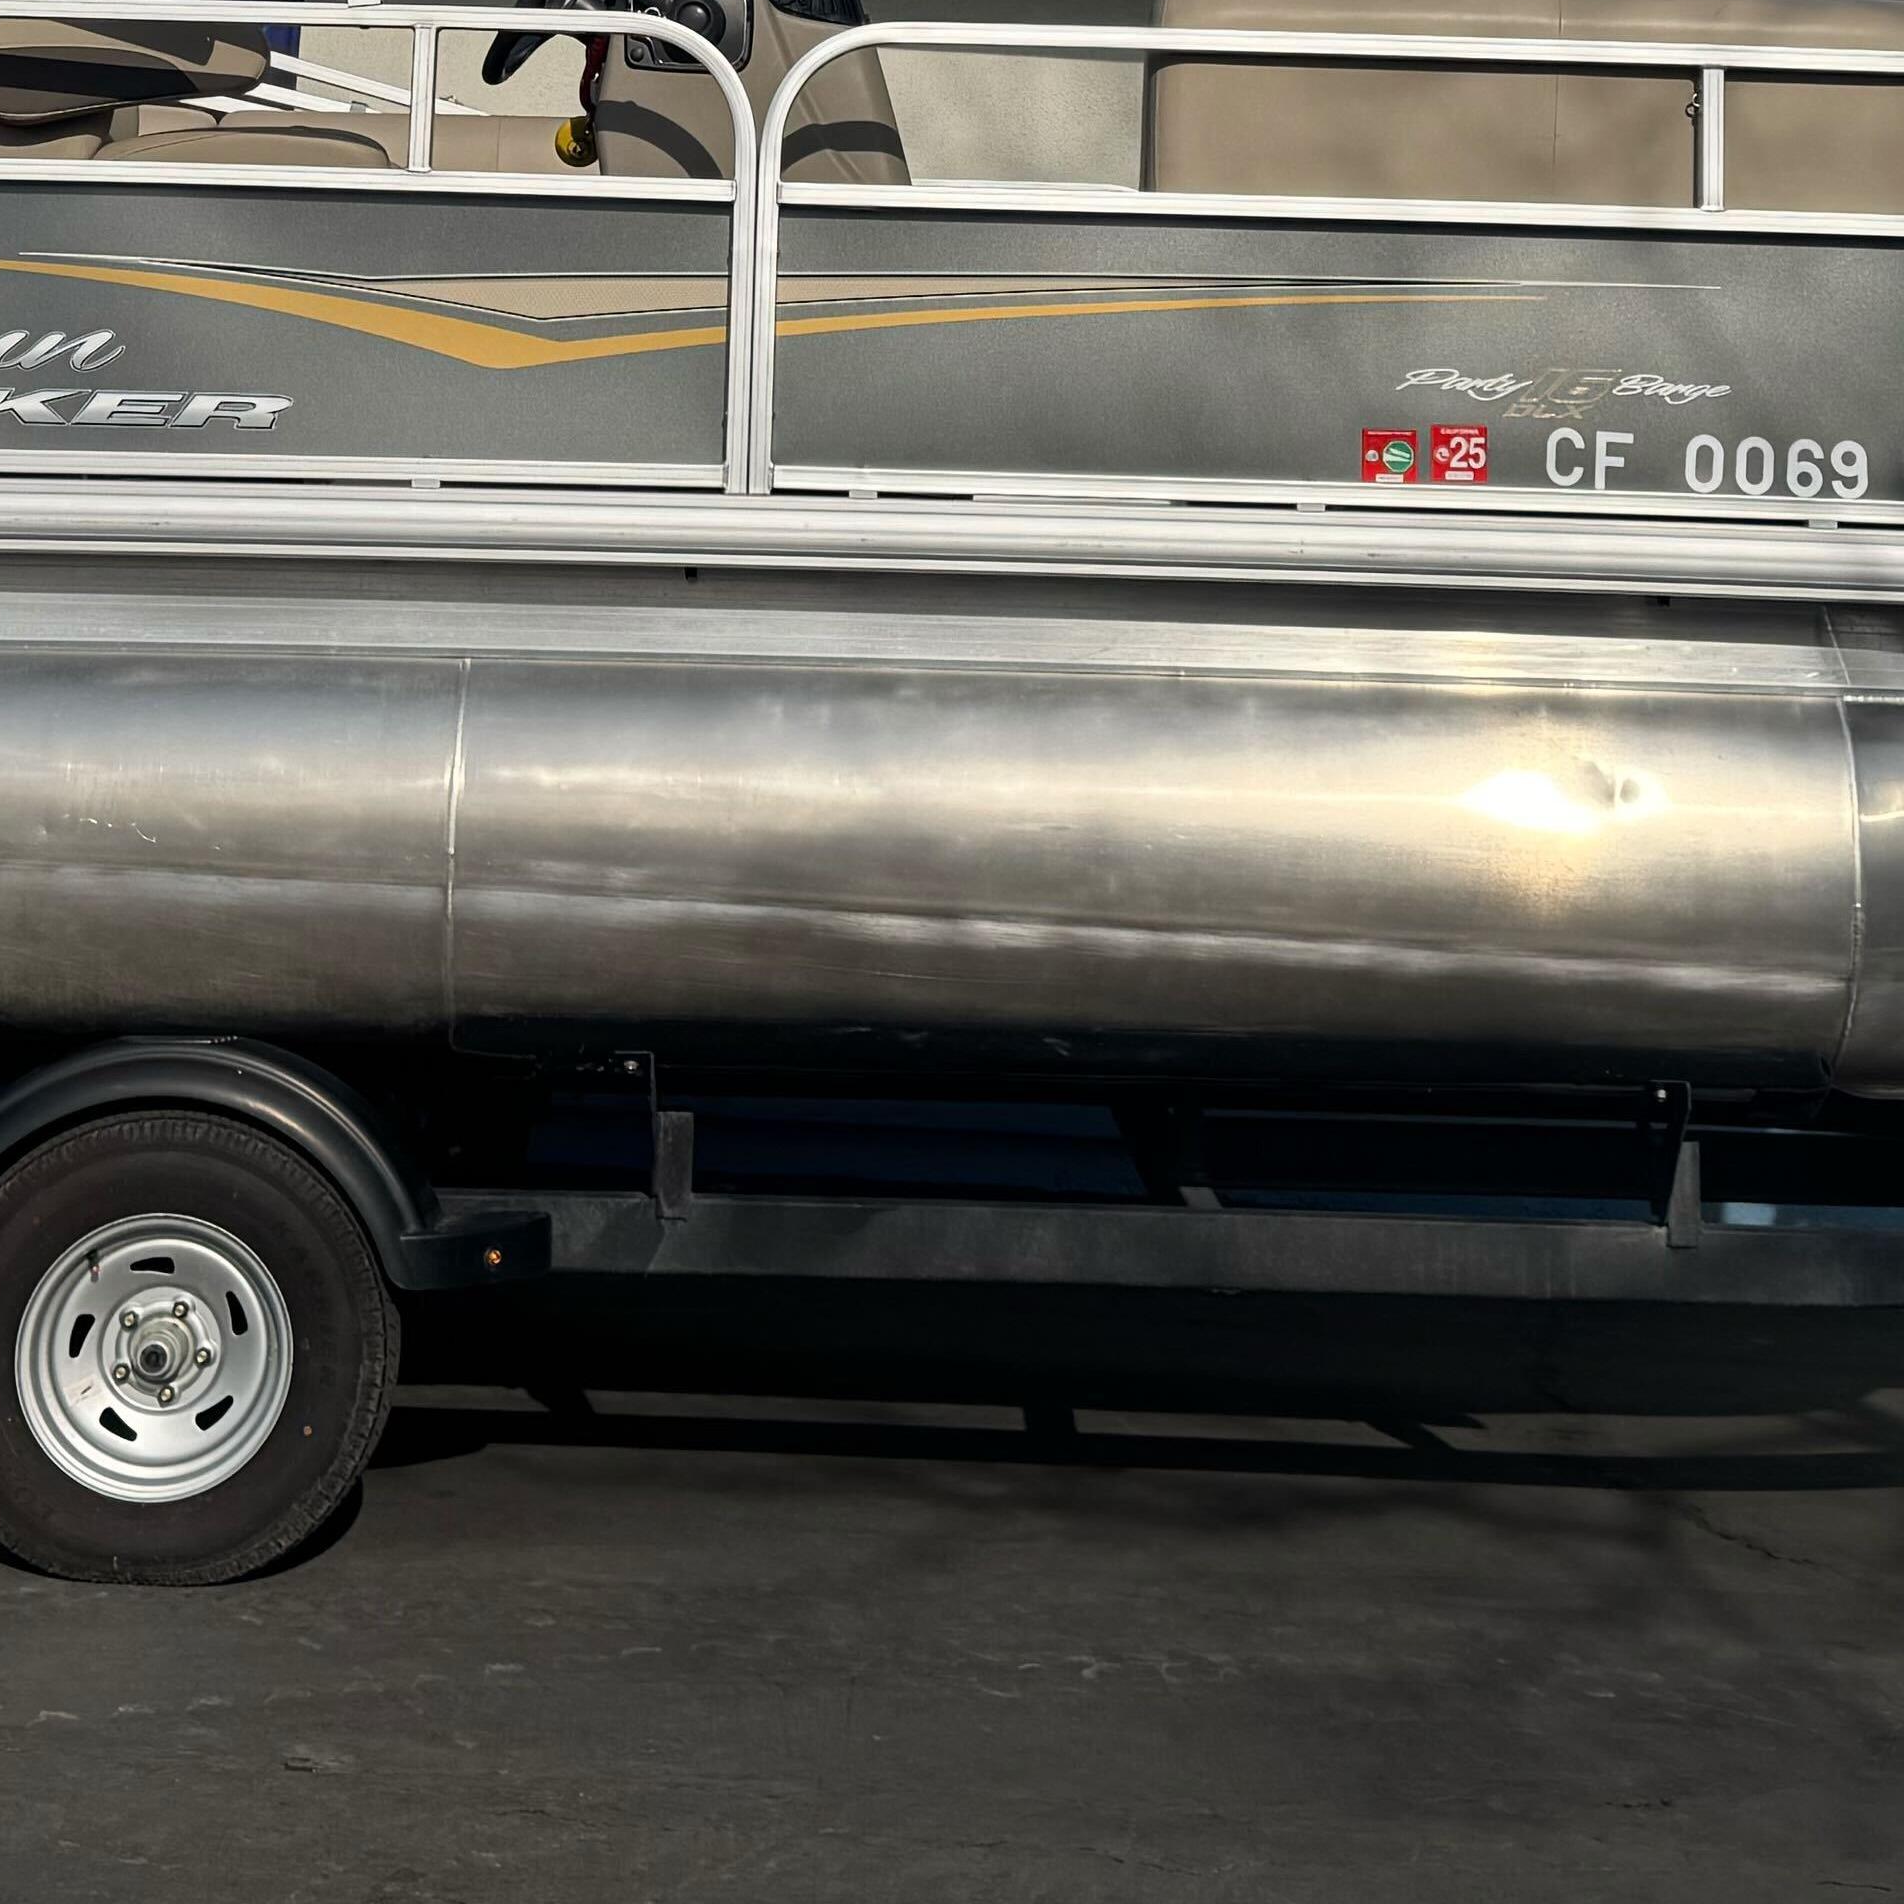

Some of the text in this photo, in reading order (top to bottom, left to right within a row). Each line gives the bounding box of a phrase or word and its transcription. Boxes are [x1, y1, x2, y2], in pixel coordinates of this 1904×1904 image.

[1395, 368, 1533, 401] Party
[1612, 374, 1731, 405] Barge
[1449, 436, 1487, 469] 25
[1545, 427, 1634, 490] CF
[1684, 433, 1870, 500] 0069
